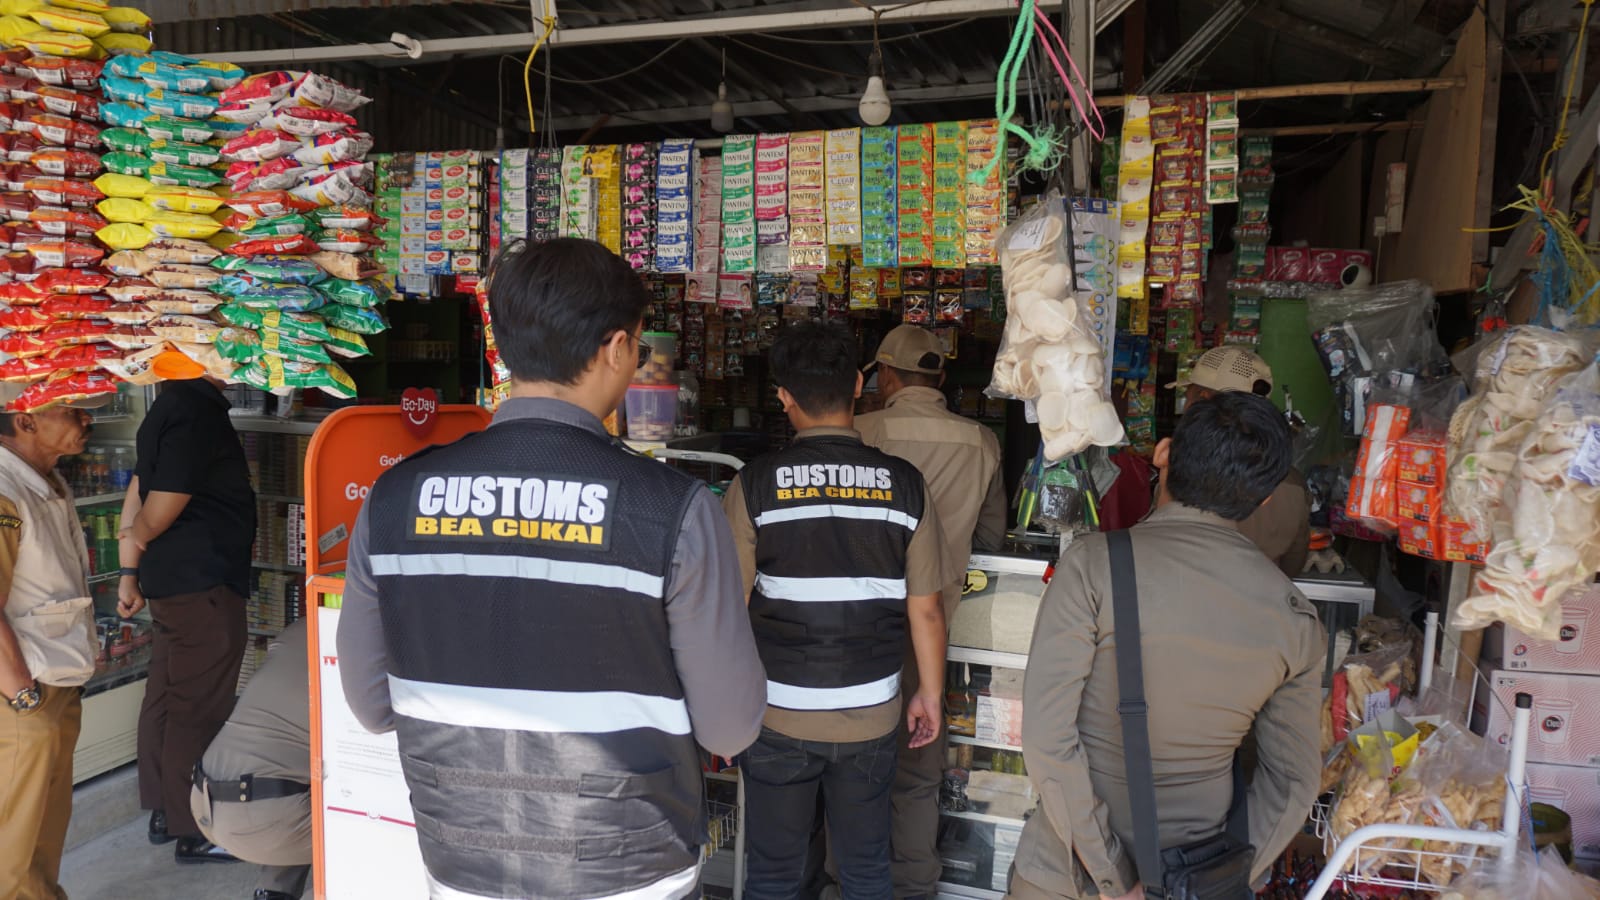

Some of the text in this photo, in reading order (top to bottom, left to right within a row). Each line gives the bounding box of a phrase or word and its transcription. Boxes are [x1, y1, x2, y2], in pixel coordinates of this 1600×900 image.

[402, 397, 436, 414] Go-Day
[379, 453, 406, 467] God
[775, 464, 892, 489] CUSTOMS
[418, 475, 609, 524] CUSTOMS
[776, 486, 893, 501] BEA CUKAI
[415, 516, 604, 545] BEA CUKAI
